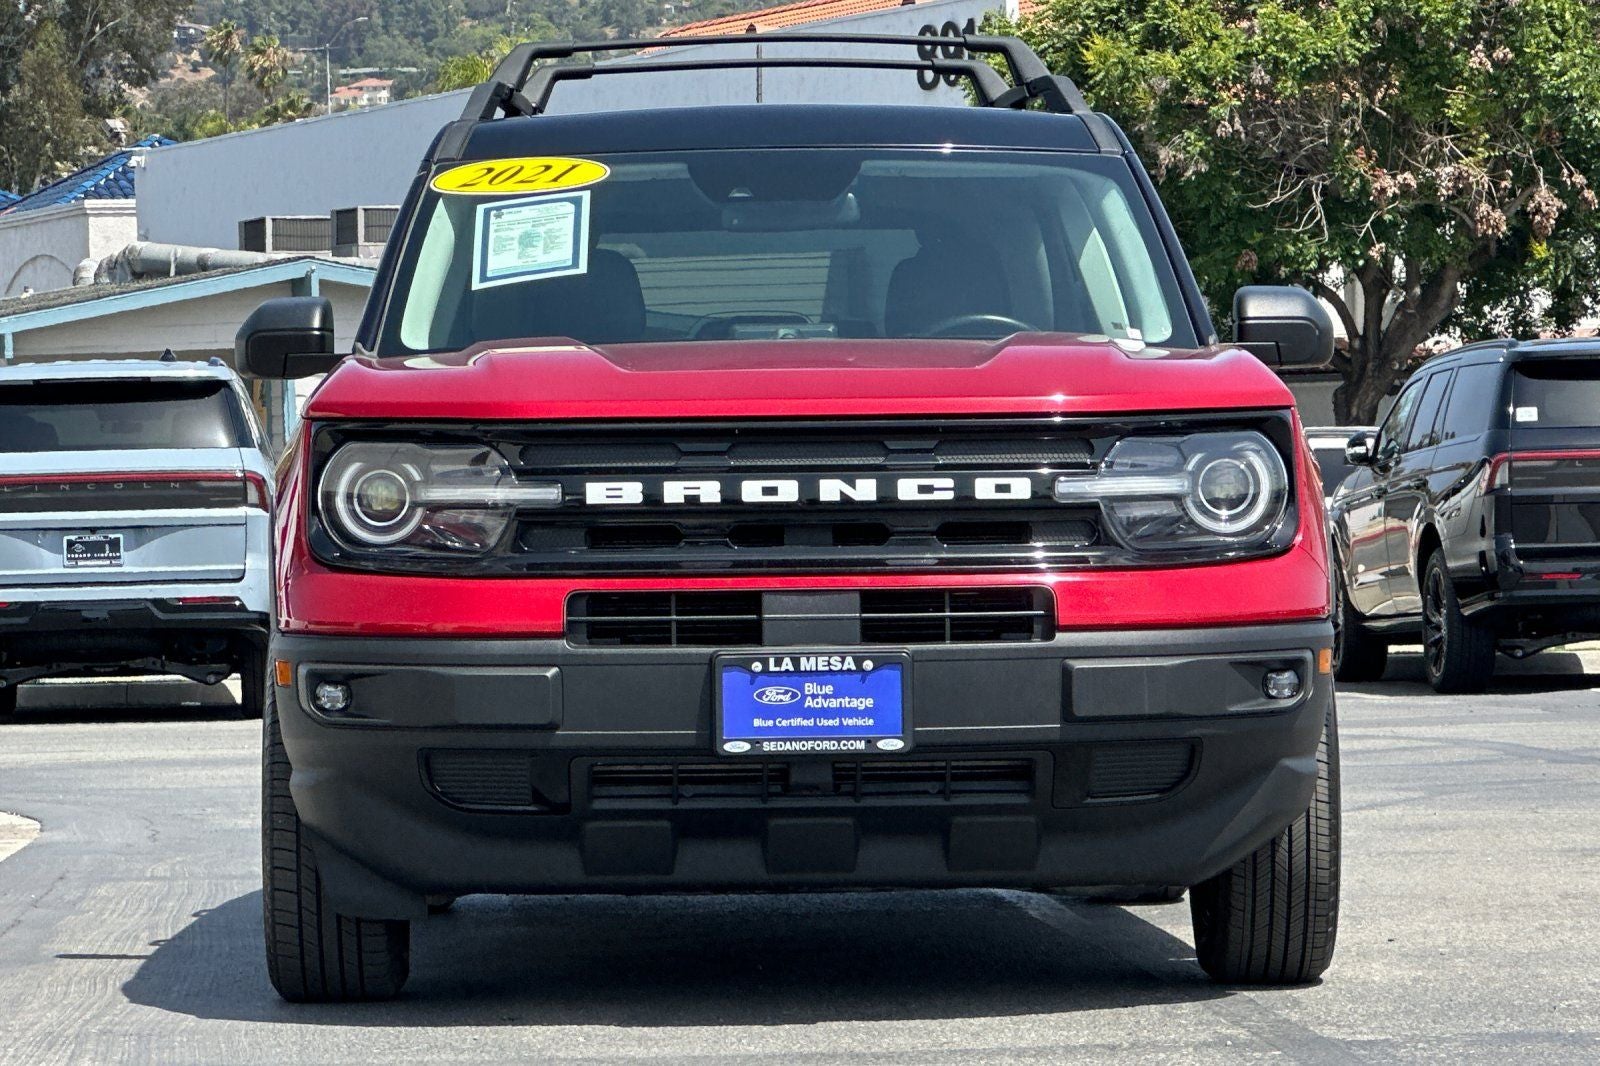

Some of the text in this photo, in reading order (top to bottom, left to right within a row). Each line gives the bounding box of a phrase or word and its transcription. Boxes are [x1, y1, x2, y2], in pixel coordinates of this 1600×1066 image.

[457, 164, 582, 188] 2021
[4, 482, 180, 492] LINCOLN
[585, 477, 1032, 504] BRONCO
[769, 656, 856, 671] LA MESA
[804, 683, 834, 695] Blue
[804, 696, 874, 710] Advantage
[753, 717, 874, 727] Blue Certified Used Vehicle
[762, 740, 865, 751] SEDANOFORD.COM
